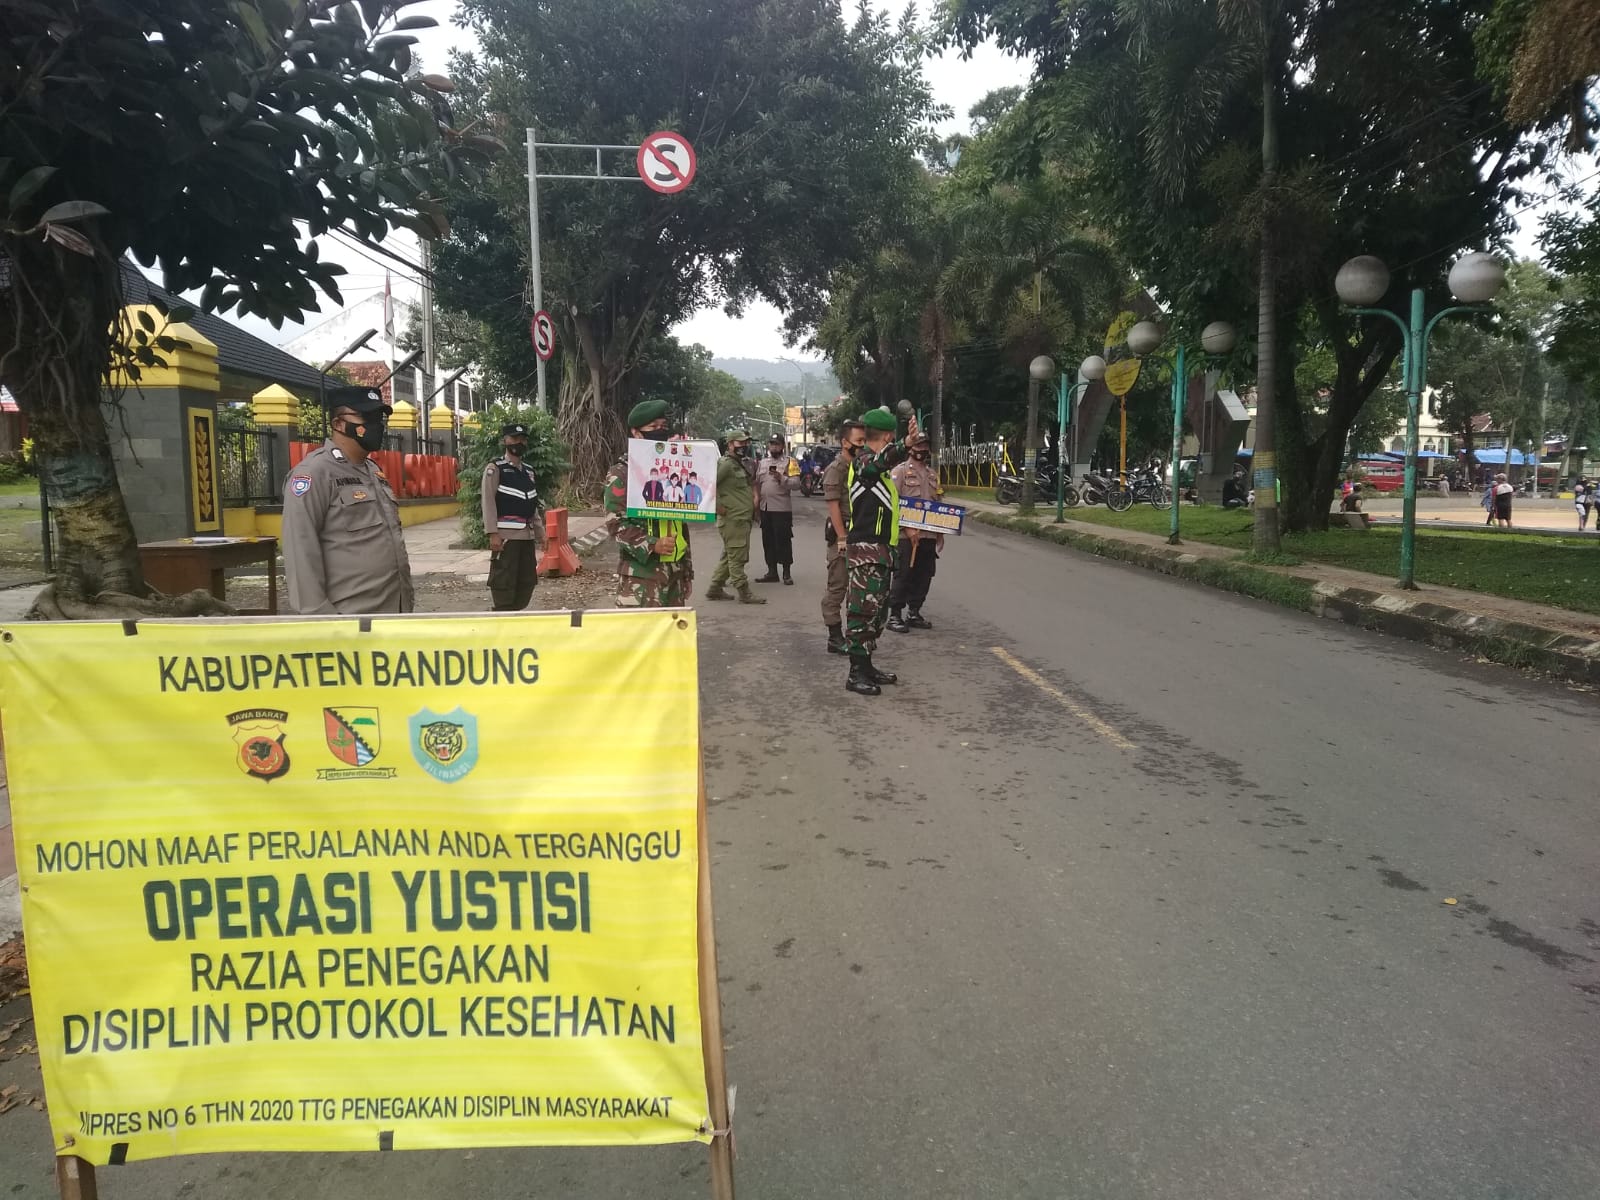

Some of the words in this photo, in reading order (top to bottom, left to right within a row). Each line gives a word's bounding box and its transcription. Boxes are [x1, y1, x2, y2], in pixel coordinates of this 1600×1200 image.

[655, 458, 693, 469] SELALU
[158, 650, 362, 692] KABUPATEN
[371, 647, 539, 687] BANDUNG
[231, 711, 254, 722] JAWA
[255, 711, 285, 720] BARAT
[36, 838, 148, 873] MOHON
[156, 832, 239, 866] MAAF
[248, 828, 430, 861] PERJALANAN
[438, 830, 511, 859] ANDA
[514, 830, 681, 862] TERGANGGU
[142, 872, 373, 941] OPERASI
[391, 869, 591, 933] YUSTISI
[190, 949, 307, 992] RAZIA
[318, 944, 549, 988] PENEGAKAN
[62, 1003, 230, 1055] DISIPLIN
[245, 997, 448, 1041] PROTOKOL
[460, 995, 675, 1044] KESEHATAN
[147, 1108, 179, 1131] NO
[184, 1105, 197, 1126] 6
[202, 1100, 244, 1123] THN
[250, 1099, 294, 1121] 2020
[299, 1098, 336, 1120] TTG
[342, 1096, 457, 1120] PENEGAKAN
[463, 1095, 540, 1117] DISIPLIN
[546, 1097, 672, 1118] MASYARAKAT
